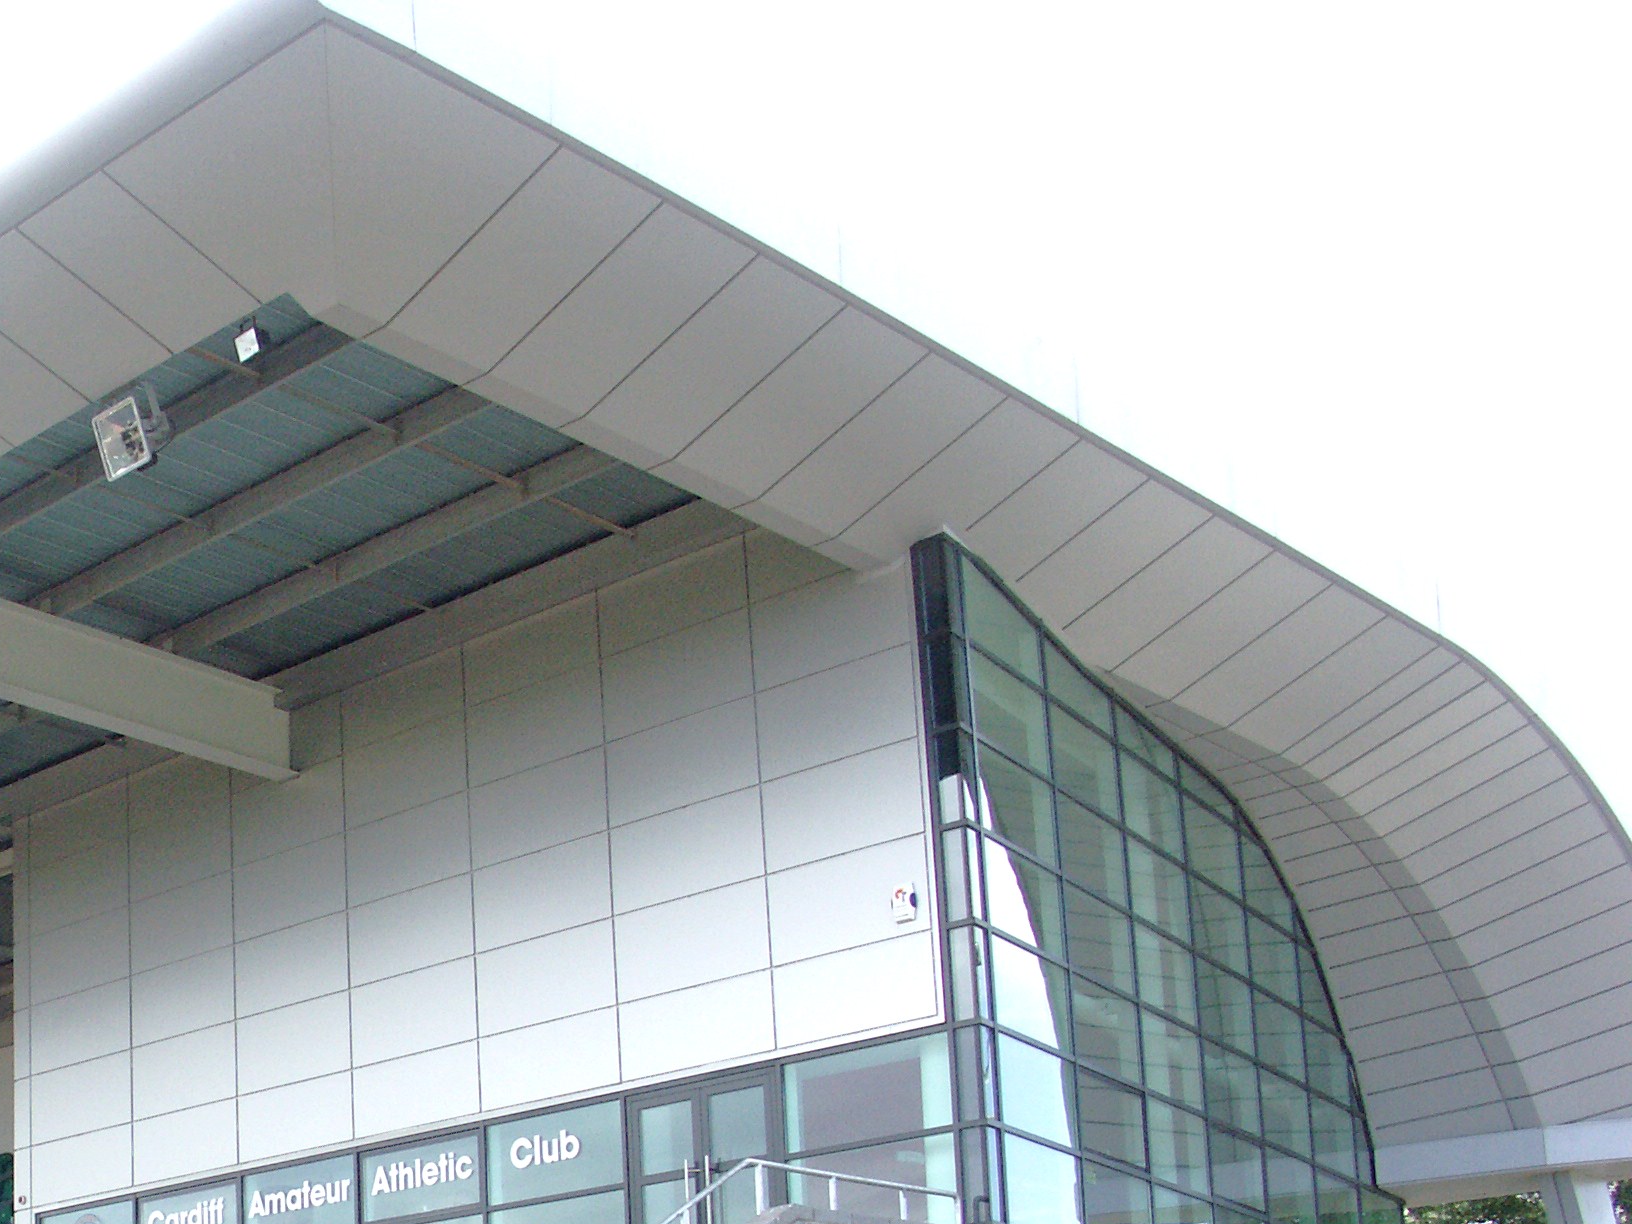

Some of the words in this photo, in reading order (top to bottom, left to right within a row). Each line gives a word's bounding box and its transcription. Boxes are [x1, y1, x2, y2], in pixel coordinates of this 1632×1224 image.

[248, 1178, 351, 1220] Amateur
[371, 1152, 473, 1196] Athletic
[510, 1129, 581, 1169] Club
